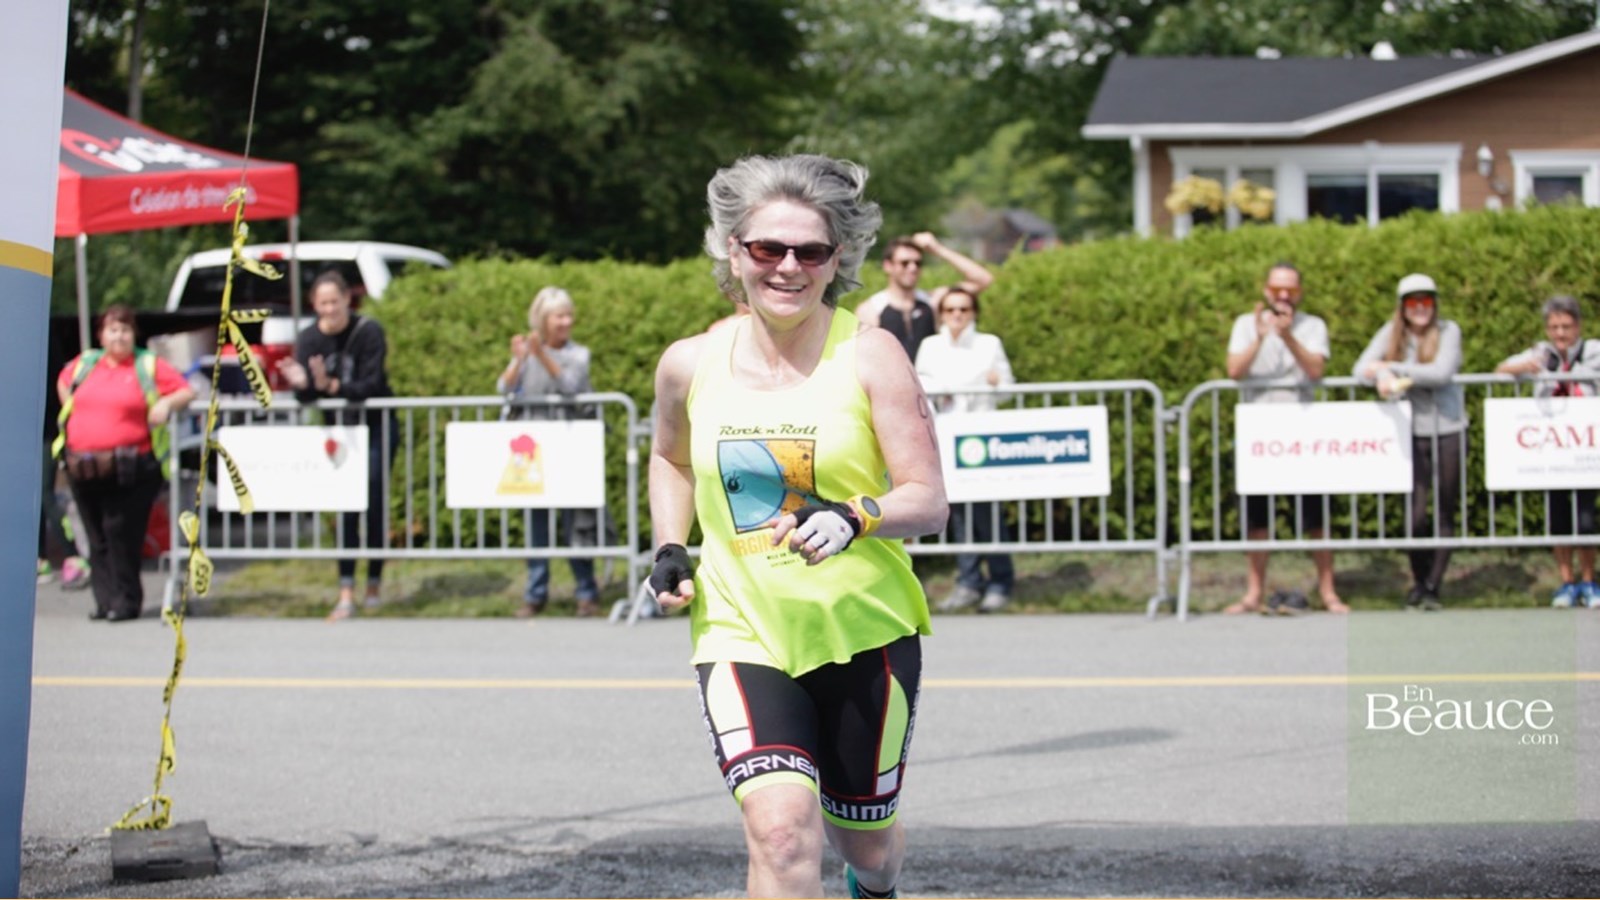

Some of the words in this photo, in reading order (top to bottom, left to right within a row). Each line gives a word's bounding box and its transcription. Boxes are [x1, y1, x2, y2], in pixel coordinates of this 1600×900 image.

[719, 425, 762, 436] Rock
[780, 423, 819, 436] Roll
[987, 434, 1088, 463] familiprix
